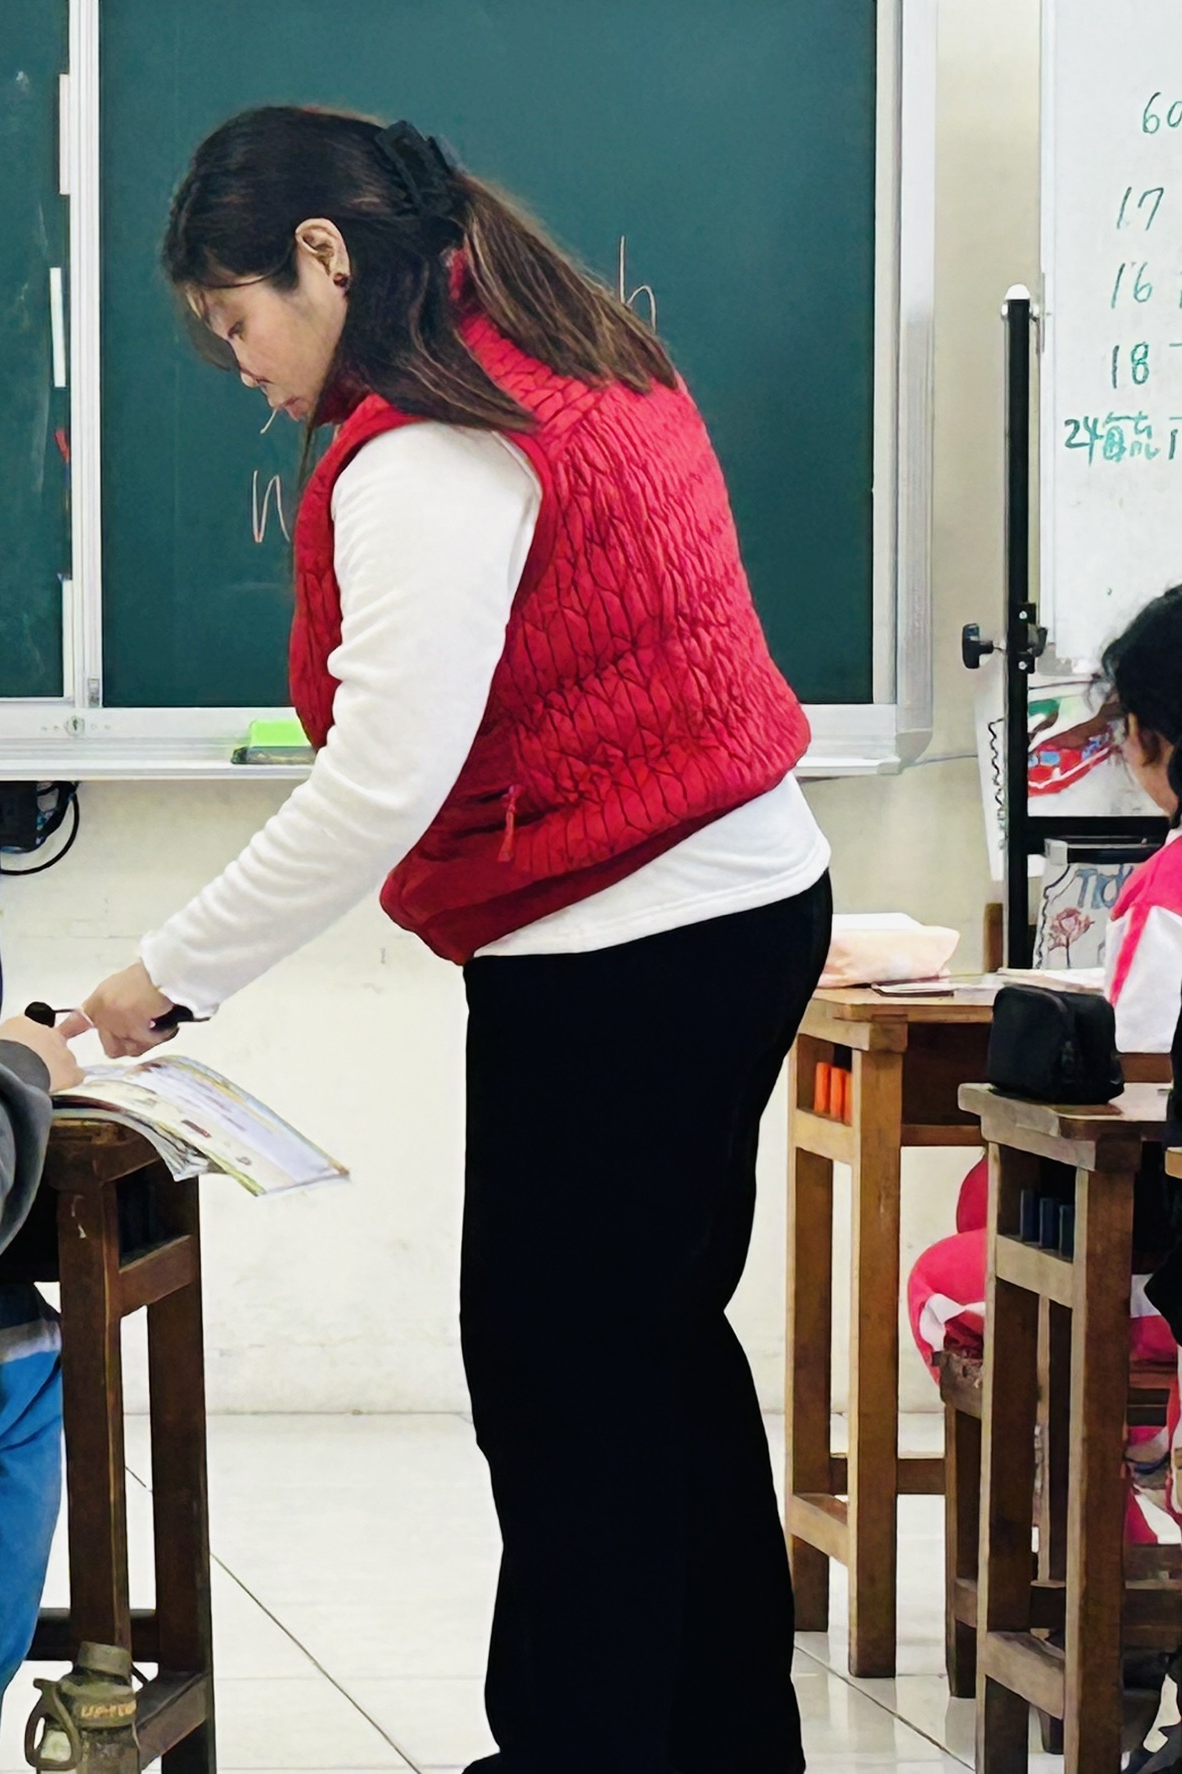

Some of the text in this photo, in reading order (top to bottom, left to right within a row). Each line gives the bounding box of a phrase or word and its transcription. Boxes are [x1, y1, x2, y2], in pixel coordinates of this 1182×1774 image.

[1116, 186, 1165, 231] 17
[1111, 261, 1154, 310] 16
[1111, 341, 1150, 389] 18
